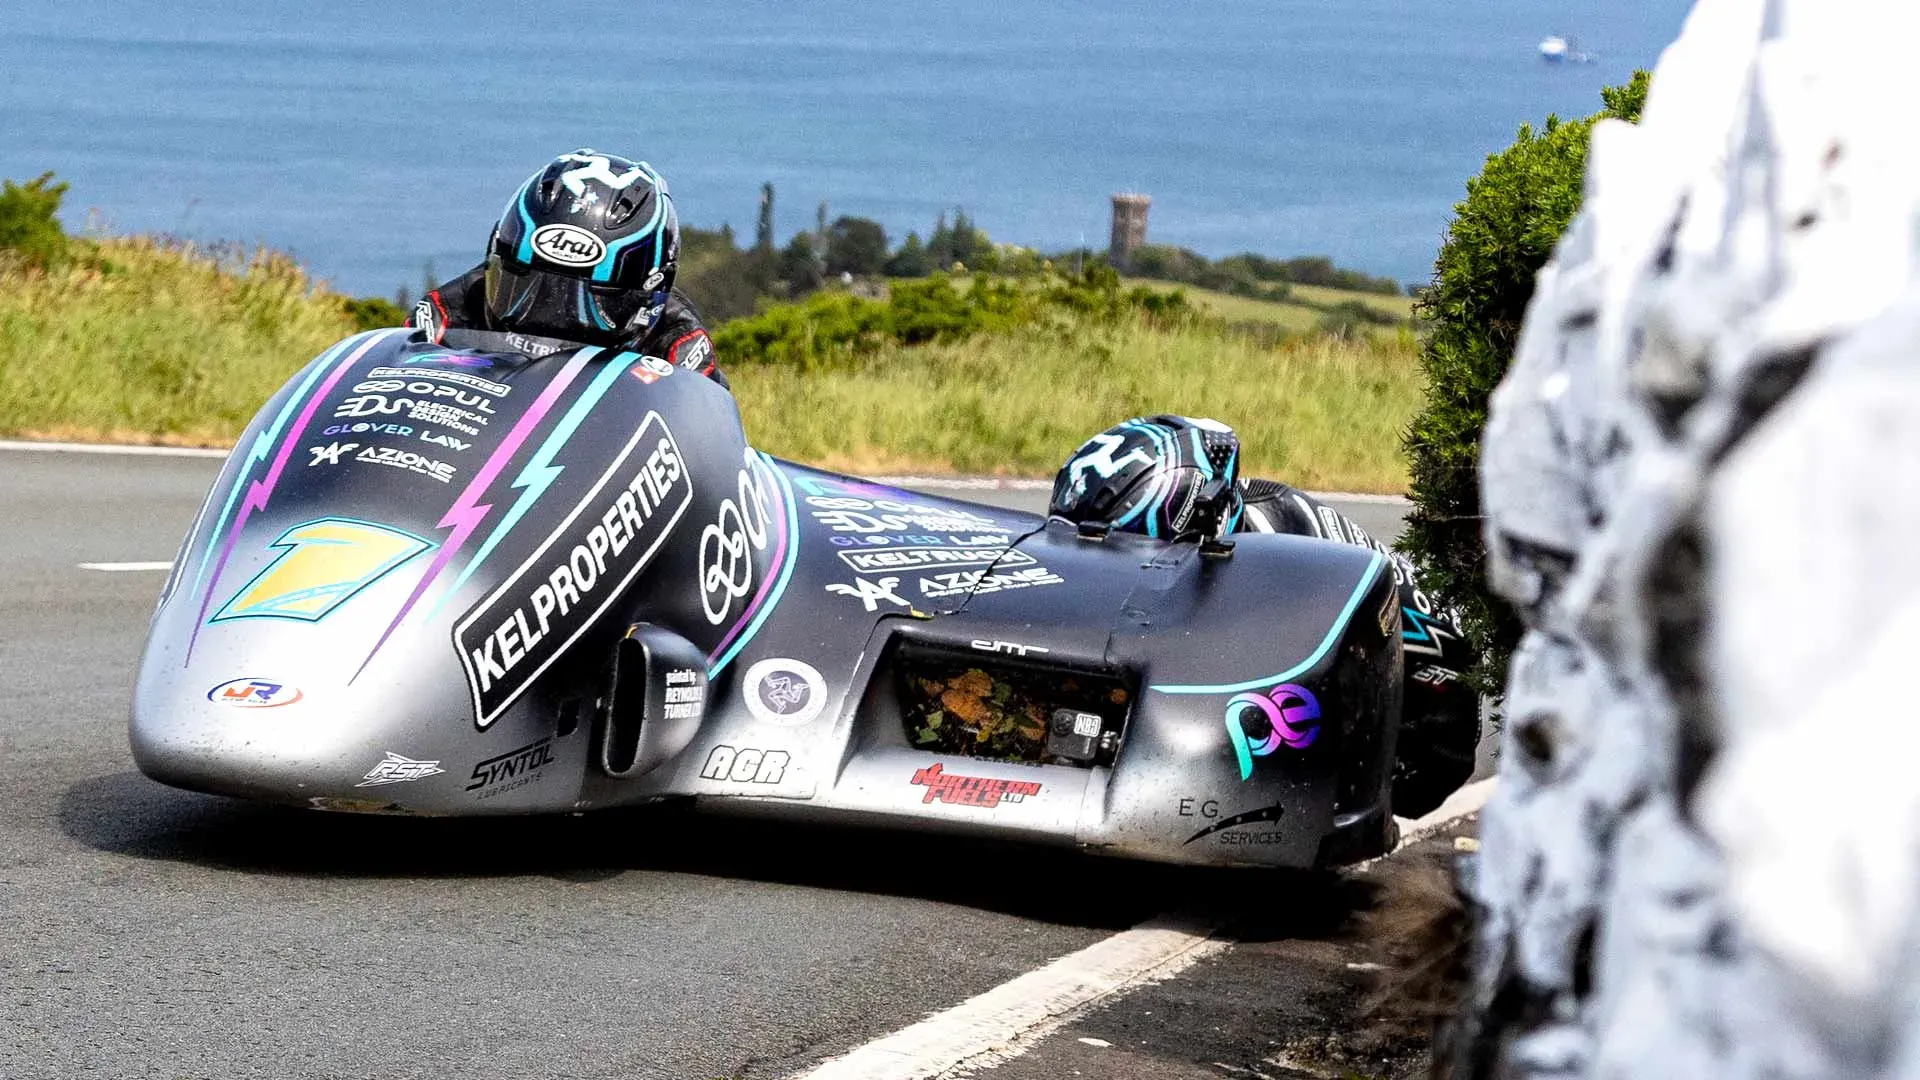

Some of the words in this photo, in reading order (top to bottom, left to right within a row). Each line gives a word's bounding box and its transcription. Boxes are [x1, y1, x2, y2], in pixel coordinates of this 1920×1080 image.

[539, 231, 594, 256] Arai
[323, 423, 413, 436] GLOVER
[420, 431, 471, 451] LAW
[357, 446, 457, 475] AZIONE
[829, 535, 943, 547] GLOVER
[473, 438, 681, 693] KELPROPERTIES
[852, 549, 1026, 568] KELTRUCK
[920, 567, 1059, 593] AZIONE
[363, 759, 441, 782] RST
[465, 737, 556, 792] SYNTOL
[699, 744, 791, 785] AGR
[910, 762, 1043, 797] NORTHERN
[921, 784, 1002, 809] FUELS
[1220, 831, 1284, 845] SERVICES
